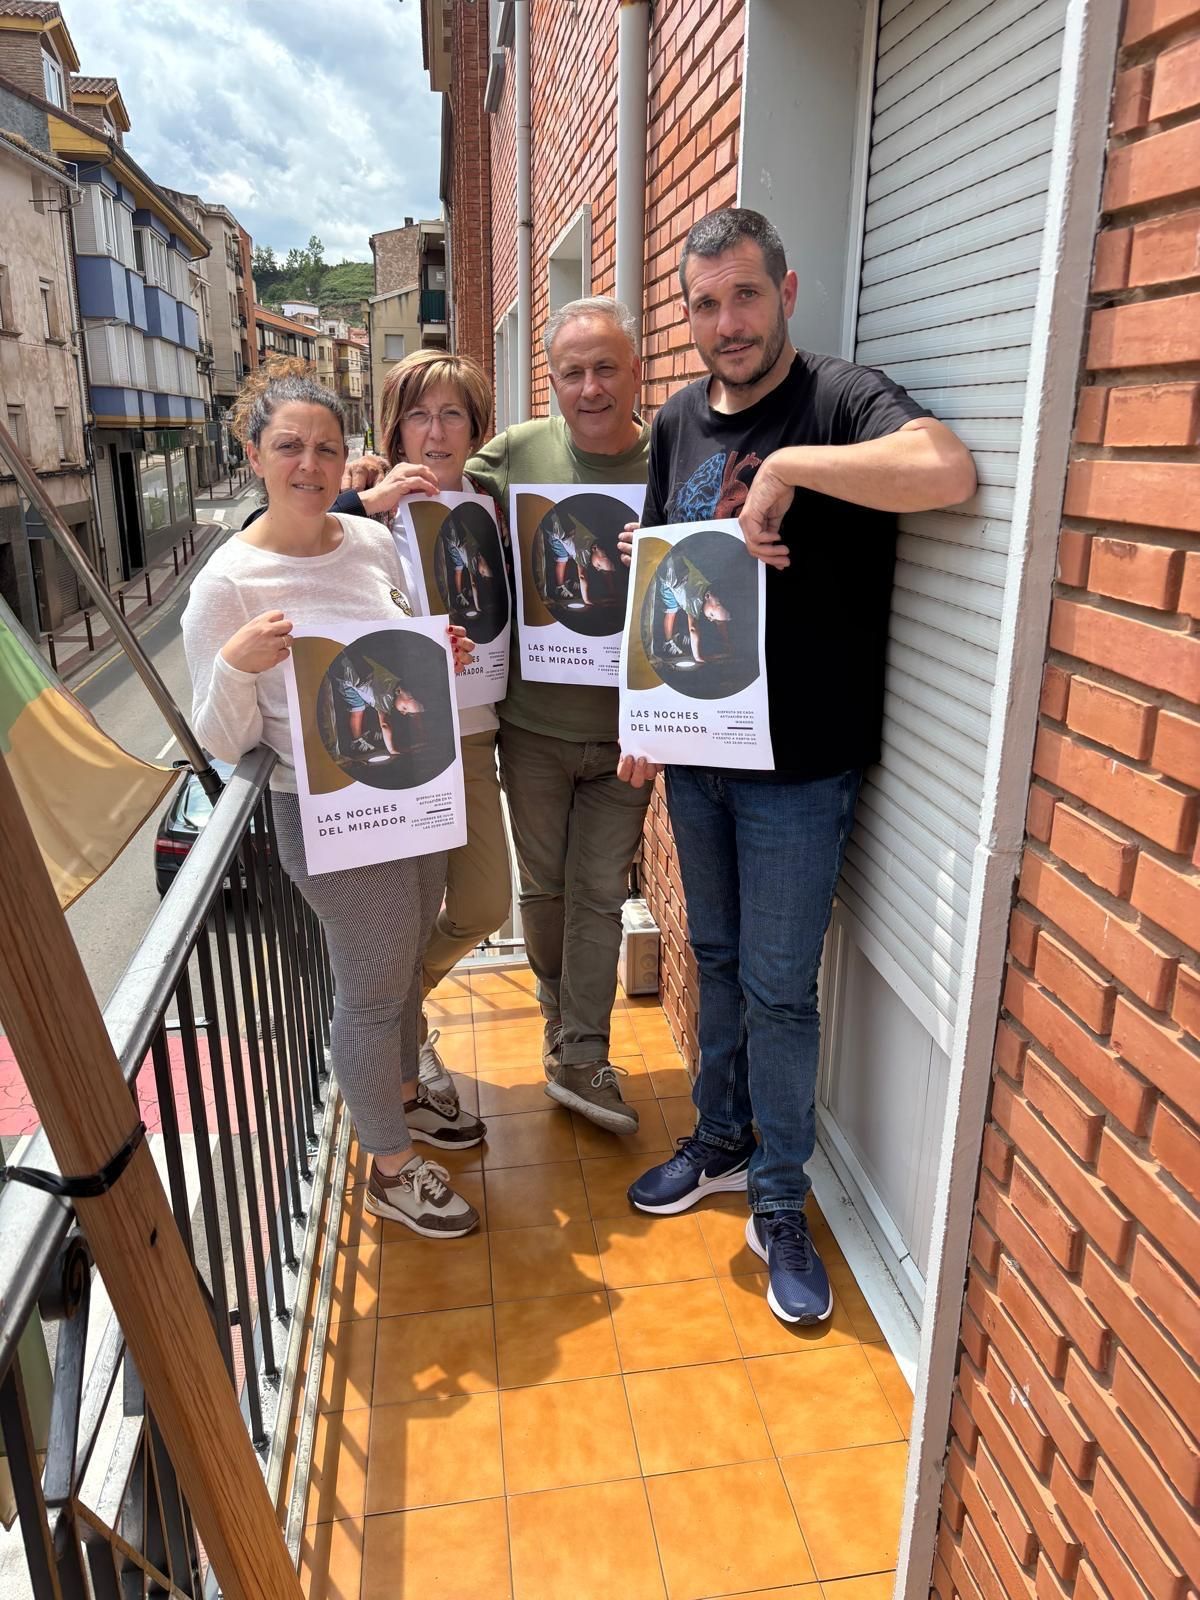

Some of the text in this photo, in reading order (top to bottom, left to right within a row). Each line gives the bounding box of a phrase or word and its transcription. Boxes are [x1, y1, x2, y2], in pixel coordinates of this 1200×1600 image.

[549, 645, 588, 654] NOCHES
[529, 654, 595, 666] DEL MIRADOR
[654, 710, 699, 720] NOCHES
[655, 724, 708, 734] MIRADOR
[317, 804, 398, 823] LAS NOCHES
[319, 816, 406, 837] DEL MIRADOR
